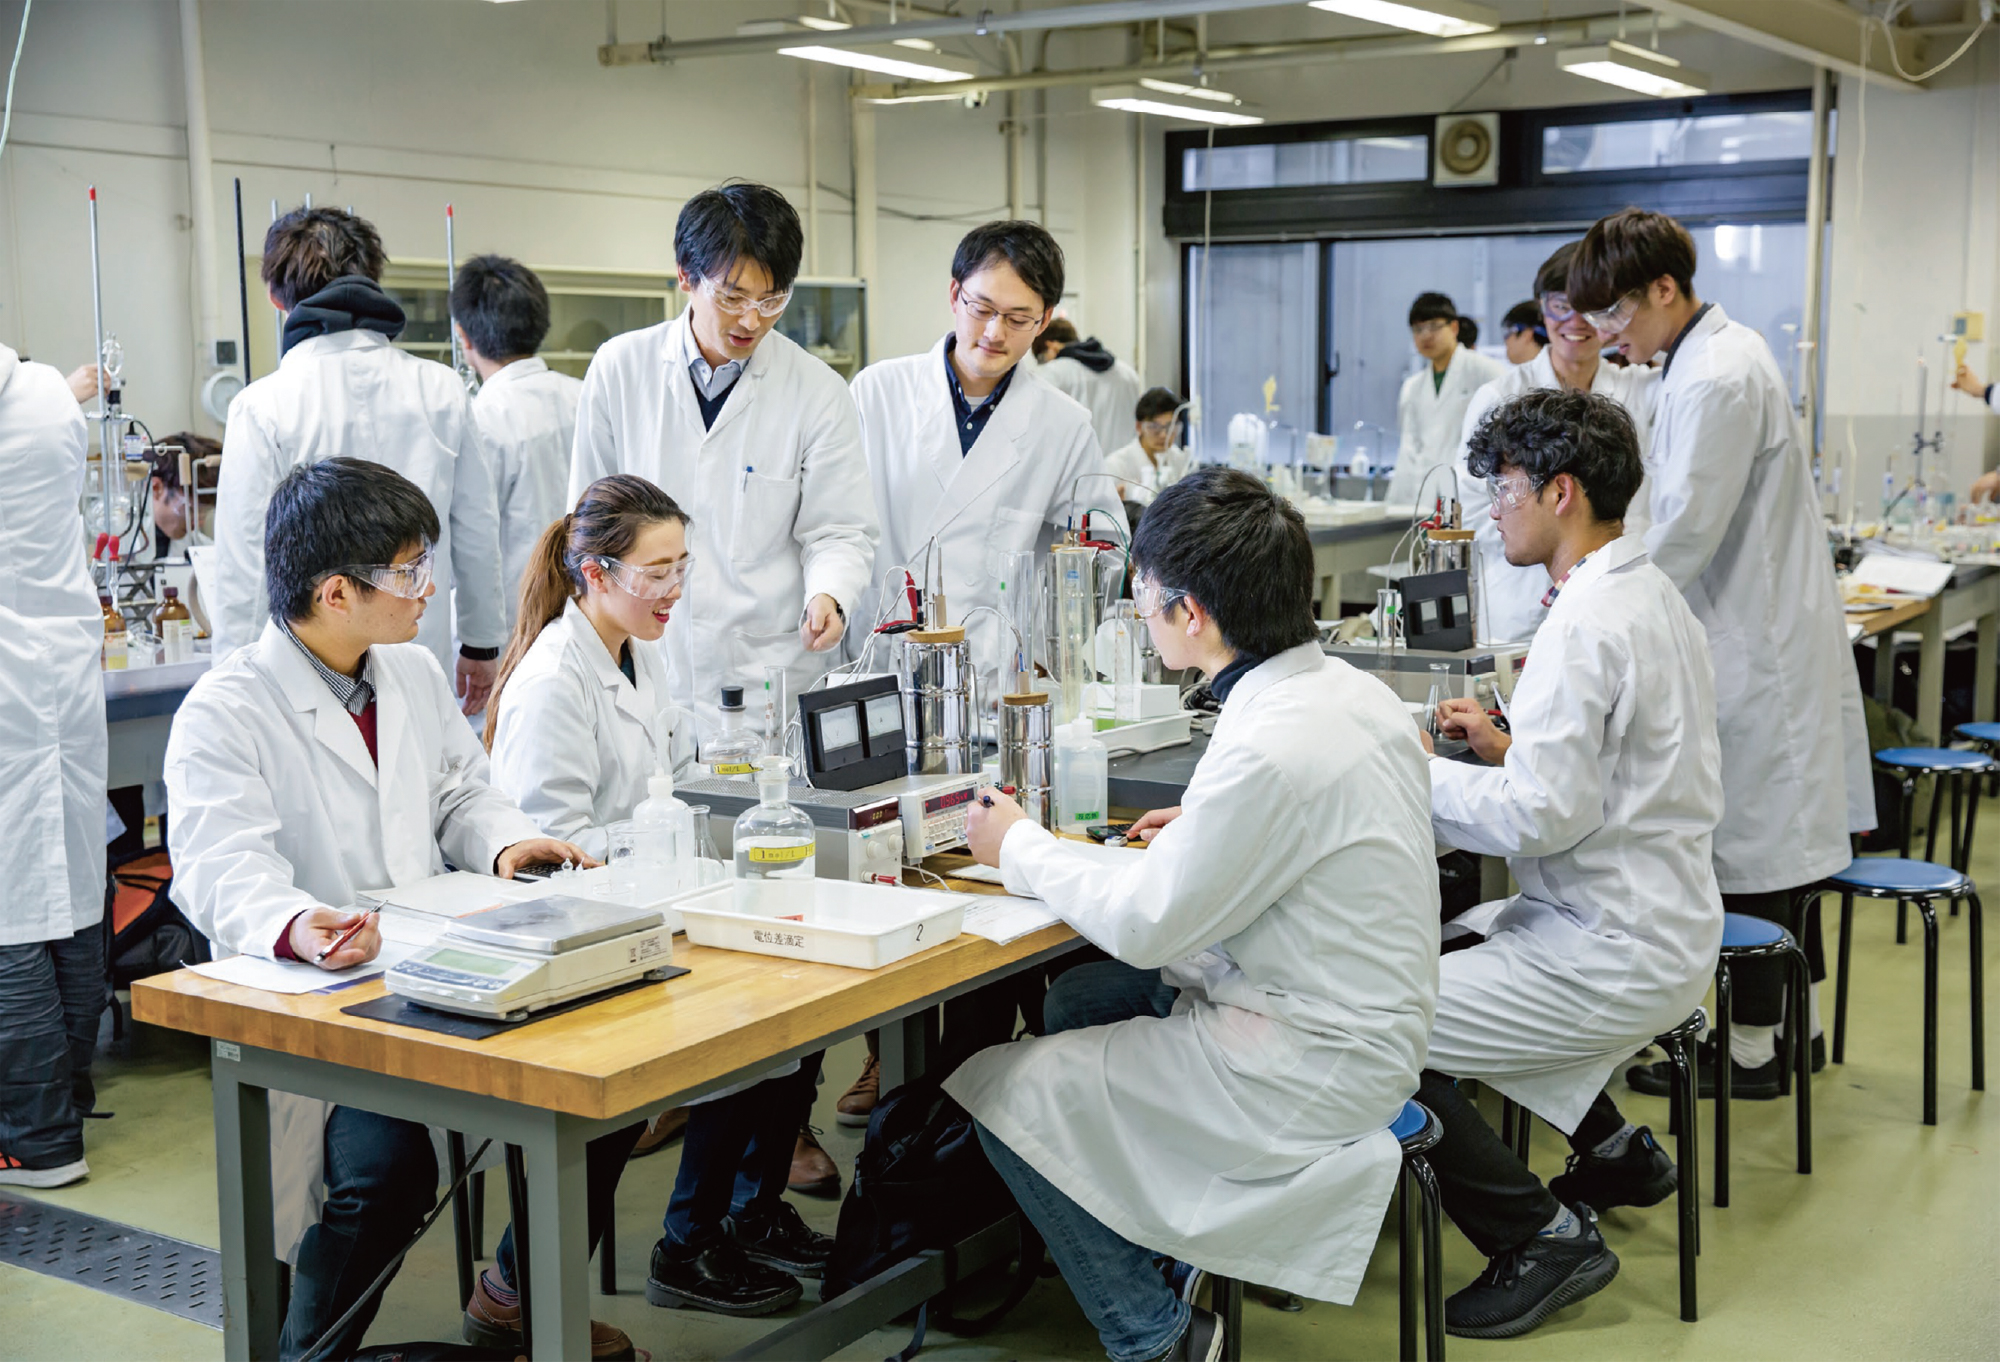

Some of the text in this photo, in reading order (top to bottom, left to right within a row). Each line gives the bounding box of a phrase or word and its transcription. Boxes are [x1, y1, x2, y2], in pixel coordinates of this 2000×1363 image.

[753, 929, 805, 948] 電位差滴定
[916, 923, 923, 942] 2
